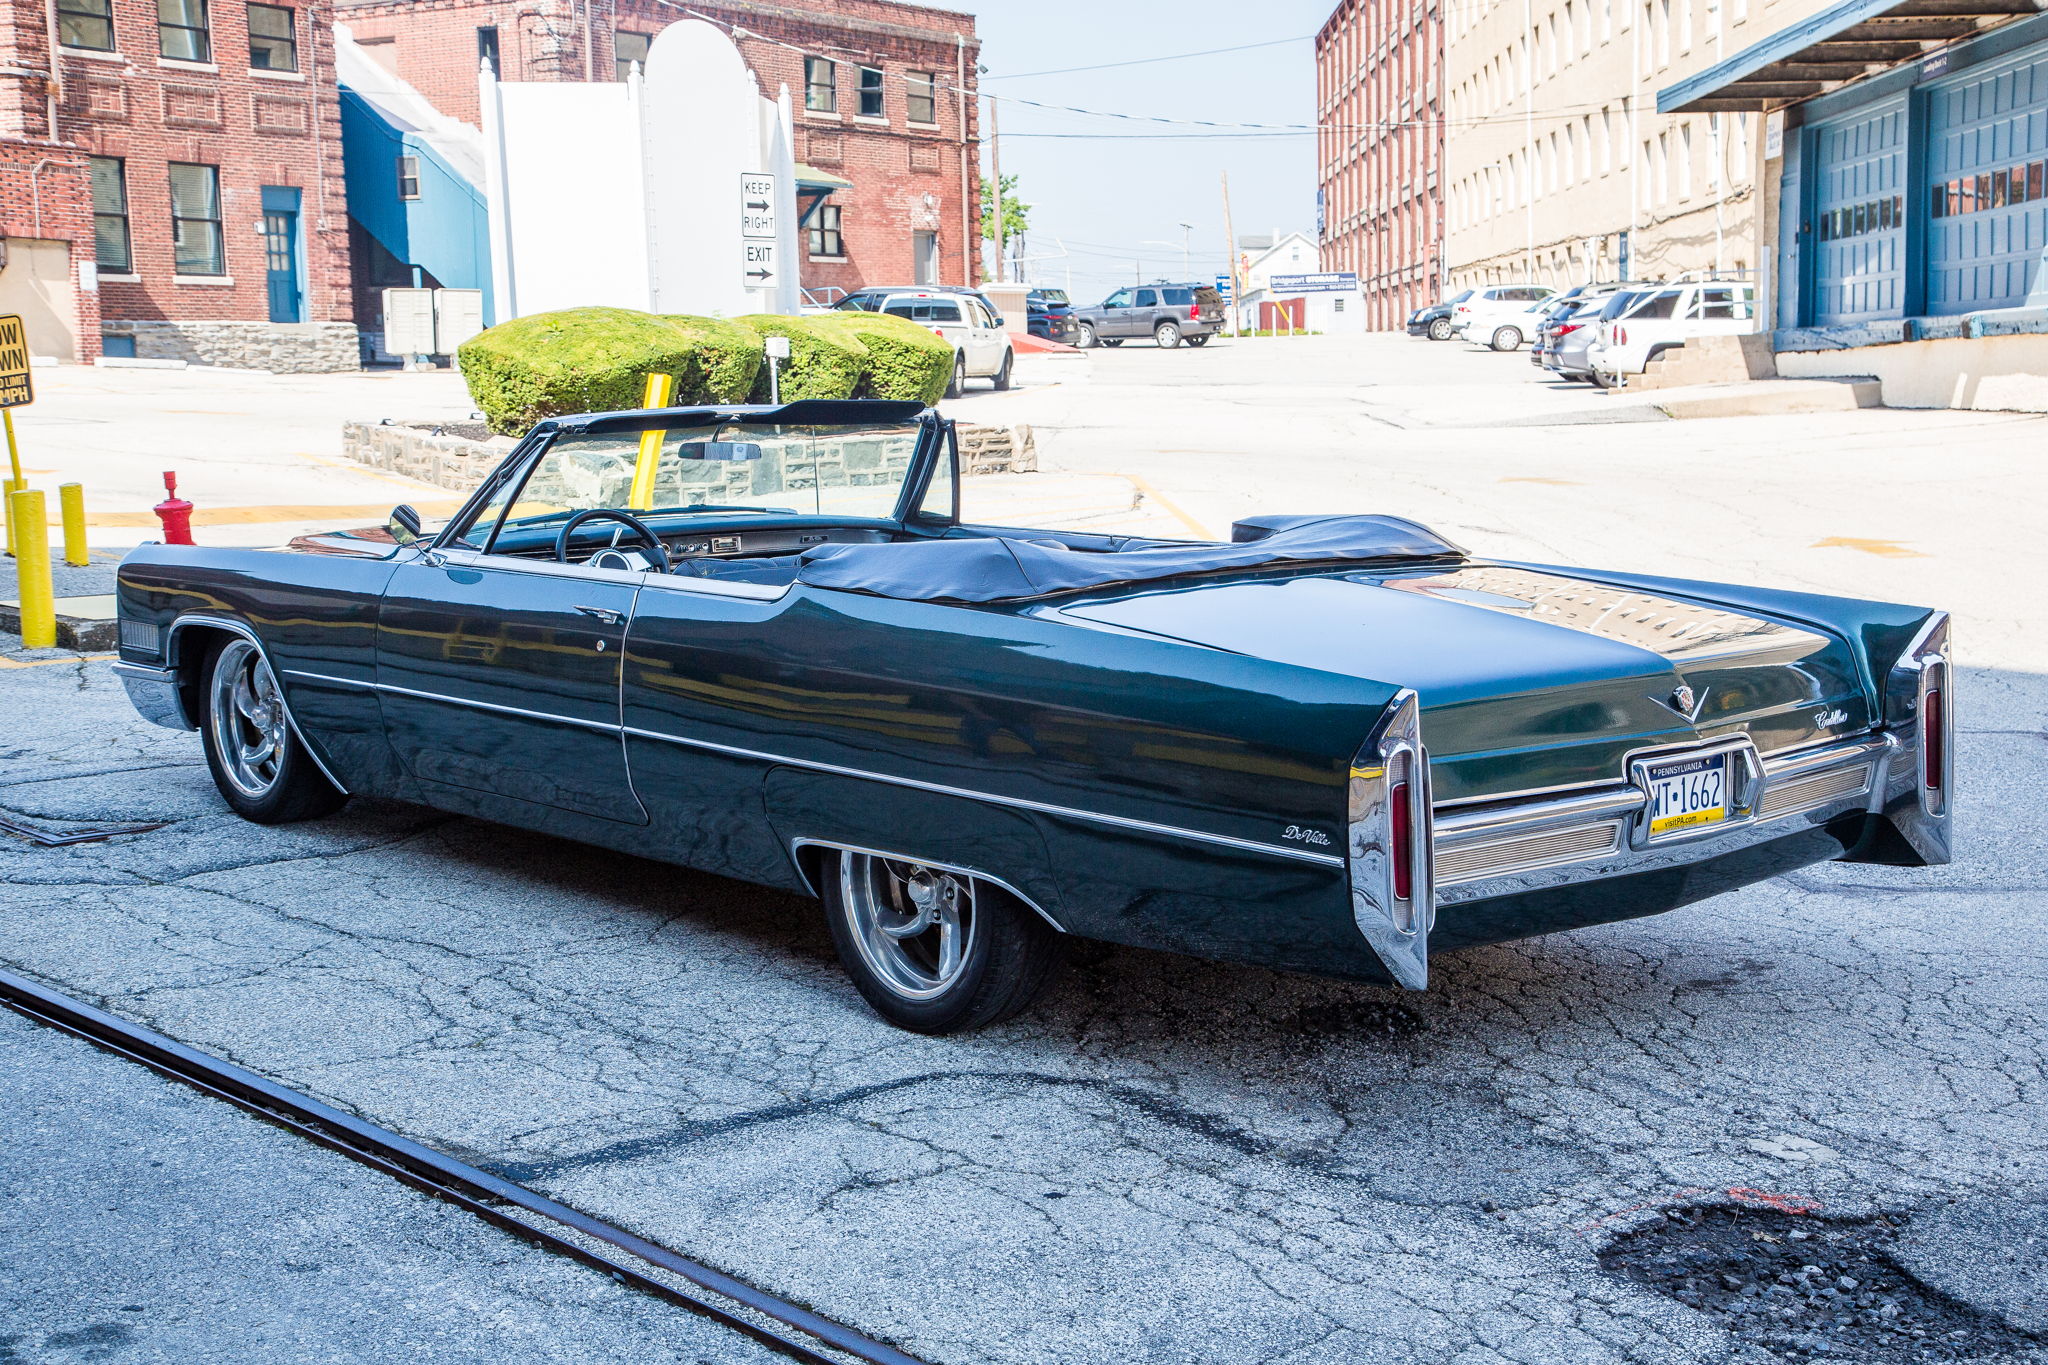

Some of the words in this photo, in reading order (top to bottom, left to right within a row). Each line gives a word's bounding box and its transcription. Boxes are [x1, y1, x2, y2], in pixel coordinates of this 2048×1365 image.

[744, 182, 771, 194] KEEP
[744, 216, 774, 229] RIGHT
[747, 246, 772, 262] EXIT
[4, 375, 26, 388] LIMIT
[0, 386, 30, 405] MPH
[1657, 761, 1703, 777] PENNSYLVANIA
[1664, 815, 1697, 828] visitPA.com
